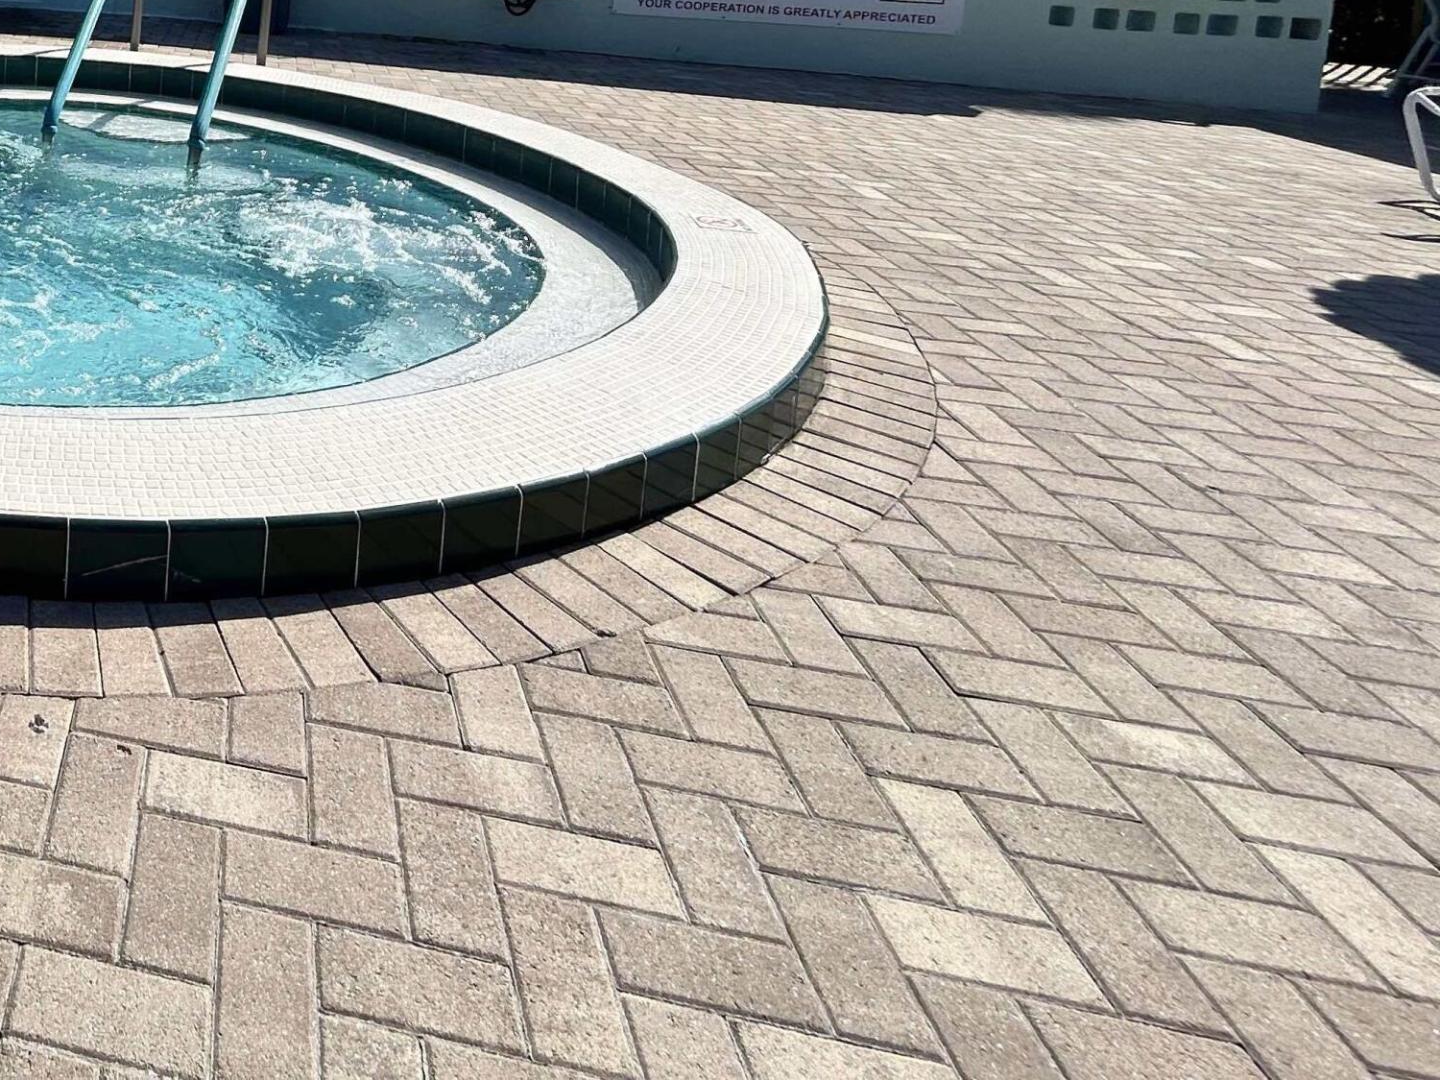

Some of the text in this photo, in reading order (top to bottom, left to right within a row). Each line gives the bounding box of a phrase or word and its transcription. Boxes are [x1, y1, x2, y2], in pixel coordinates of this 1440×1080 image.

[638, 0, 936, 25] YOUR COOPERATION IS GREATLY APPRECIATED
